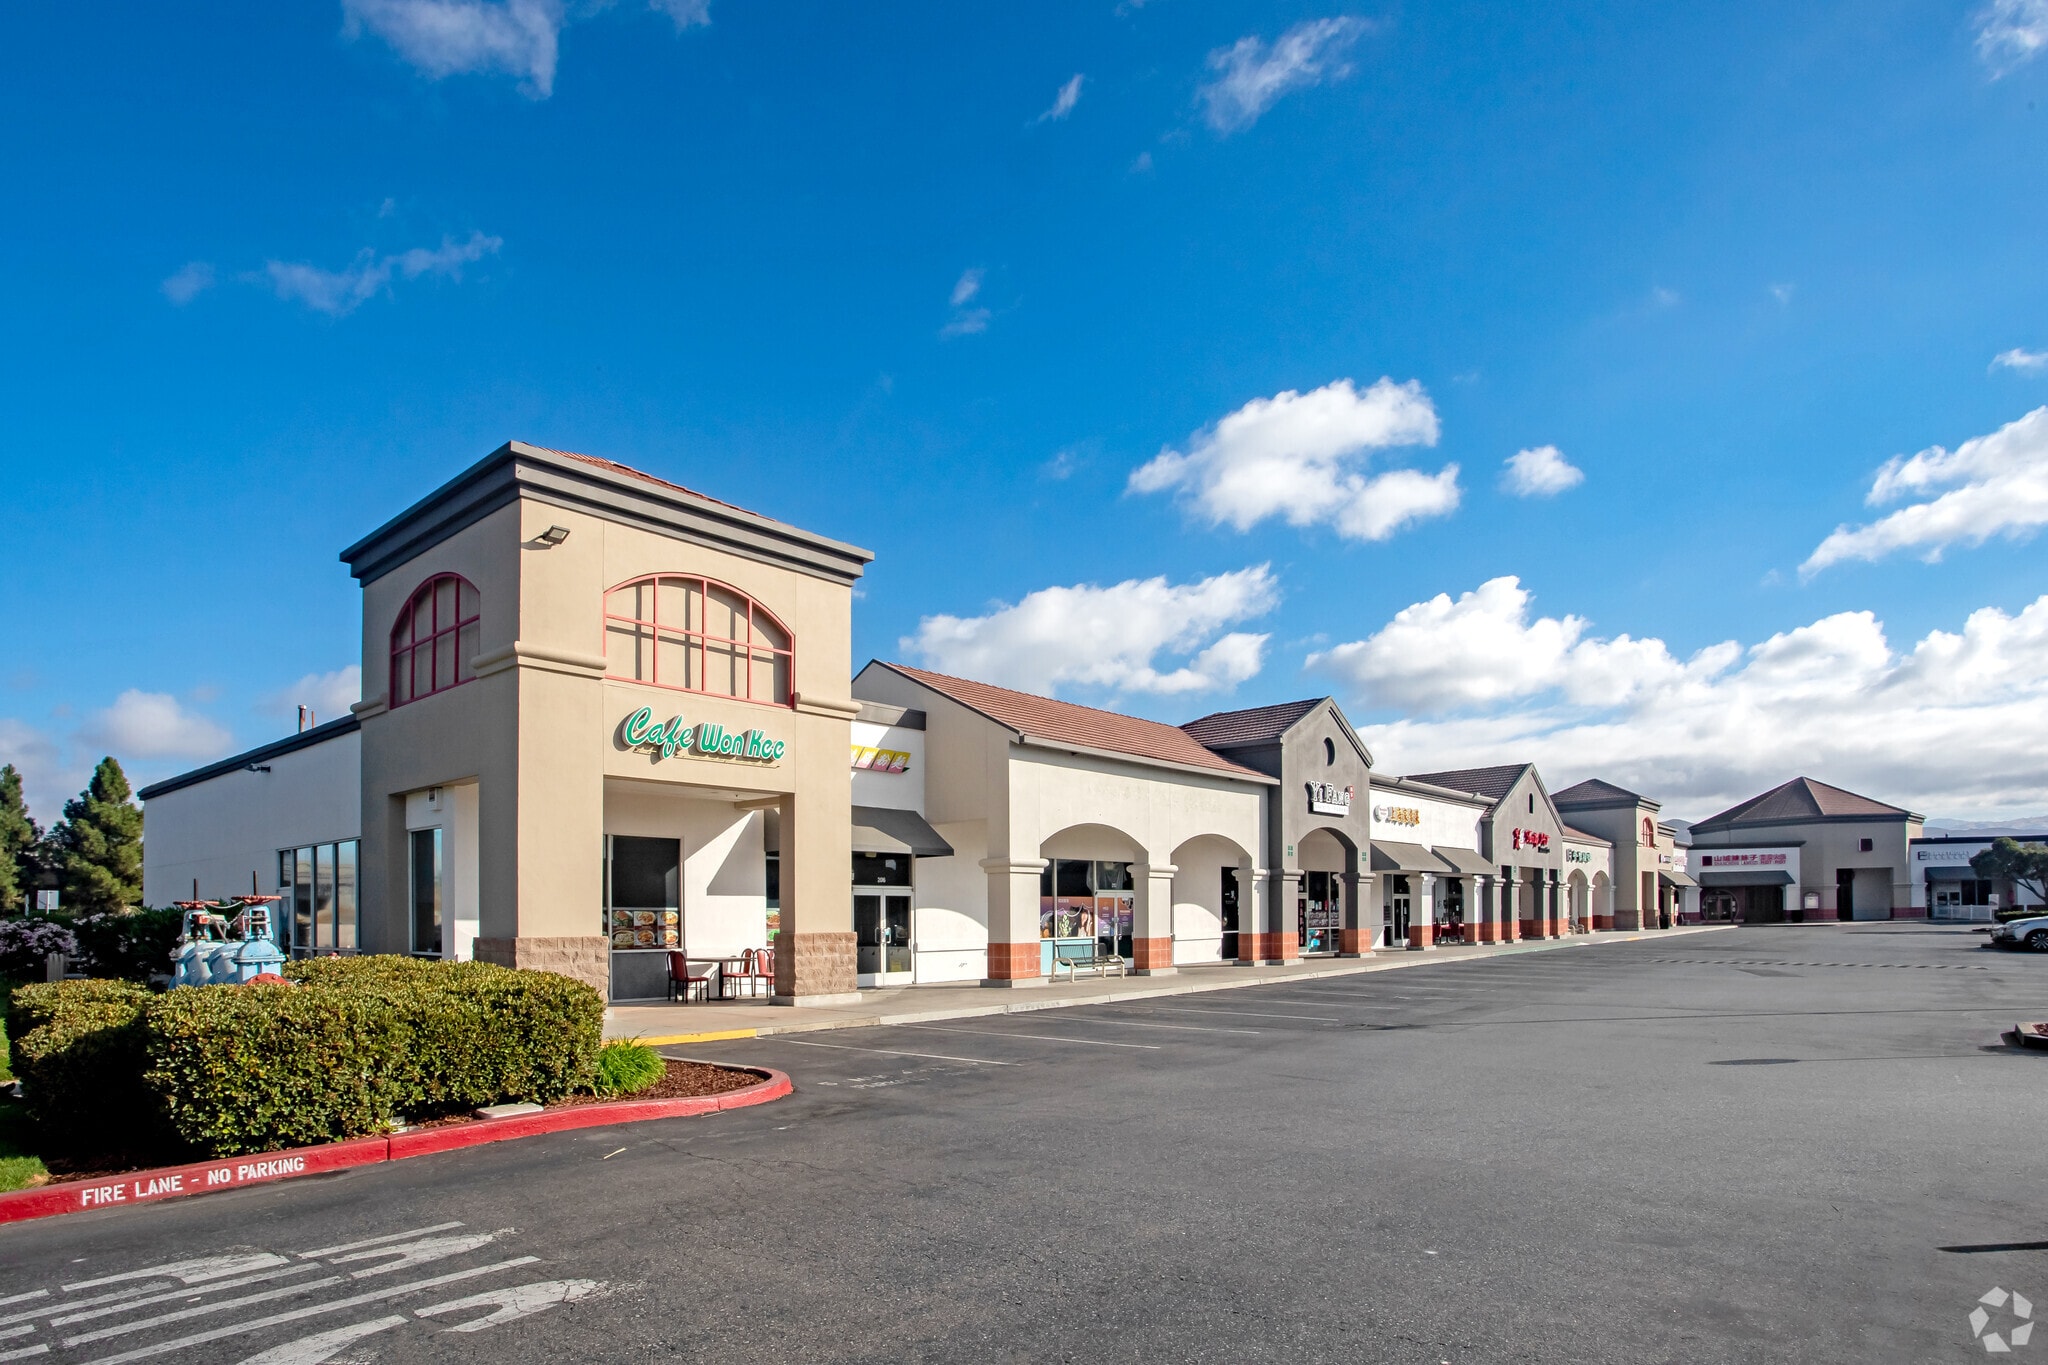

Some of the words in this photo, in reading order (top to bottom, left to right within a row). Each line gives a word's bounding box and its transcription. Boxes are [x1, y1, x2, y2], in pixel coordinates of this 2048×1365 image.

[624, 705, 695, 759] Cafe
[699, 722, 745, 755] Won
[747, 729, 785, 759] Kee
[81, 1183, 126, 1206] FIRE
[135, 1175, 183, 1198] LANE
[207, 1168, 231, 1186] NO
[238, 1157, 304, 1181] PARKING
